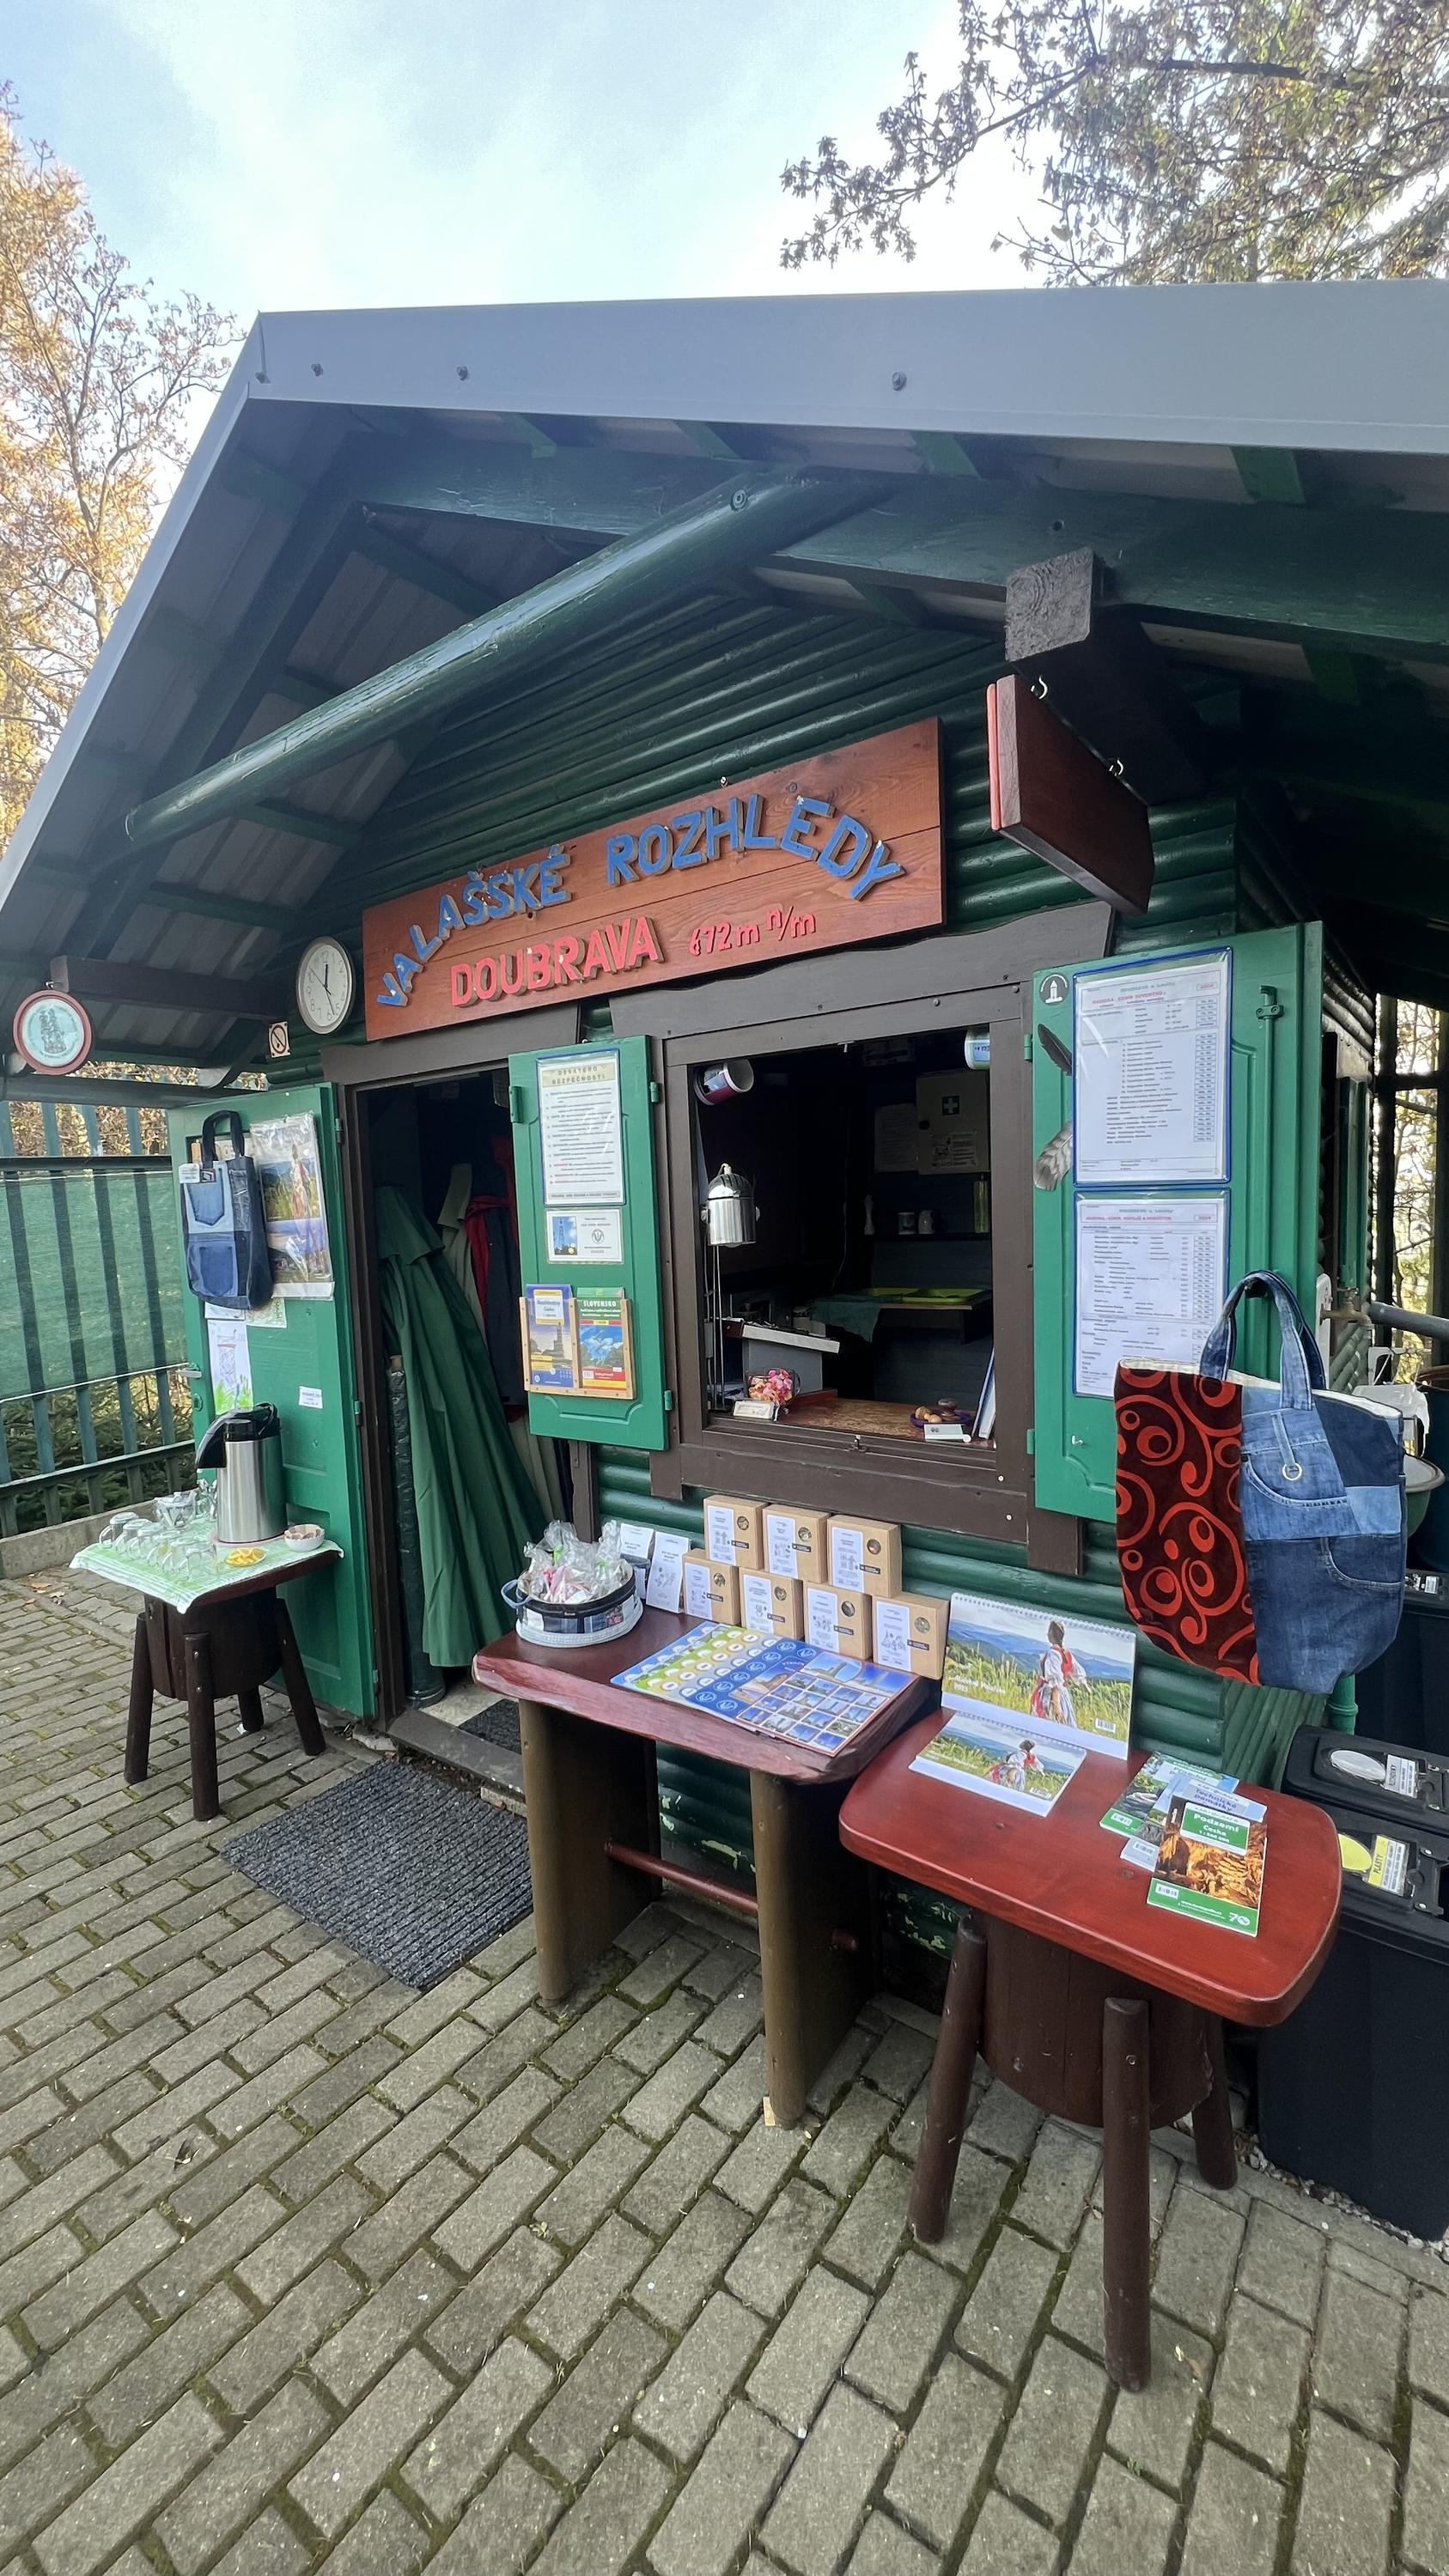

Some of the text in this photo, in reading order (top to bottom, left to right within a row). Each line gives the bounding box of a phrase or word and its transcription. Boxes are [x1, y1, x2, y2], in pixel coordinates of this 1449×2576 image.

[376, 793, 906, 1006] VALAŠSKÉ ROZHLEDY
[450, 916, 664, 1007] DOUBRAVA
[551, 1073, 606, 1084] BEZPEČNOSTI
[557, 1066, 598, 1076] DESATERO
[1193, 1813, 1239, 1832] Podzemí
[1373, 1854, 1385, 1874] PLASTY
